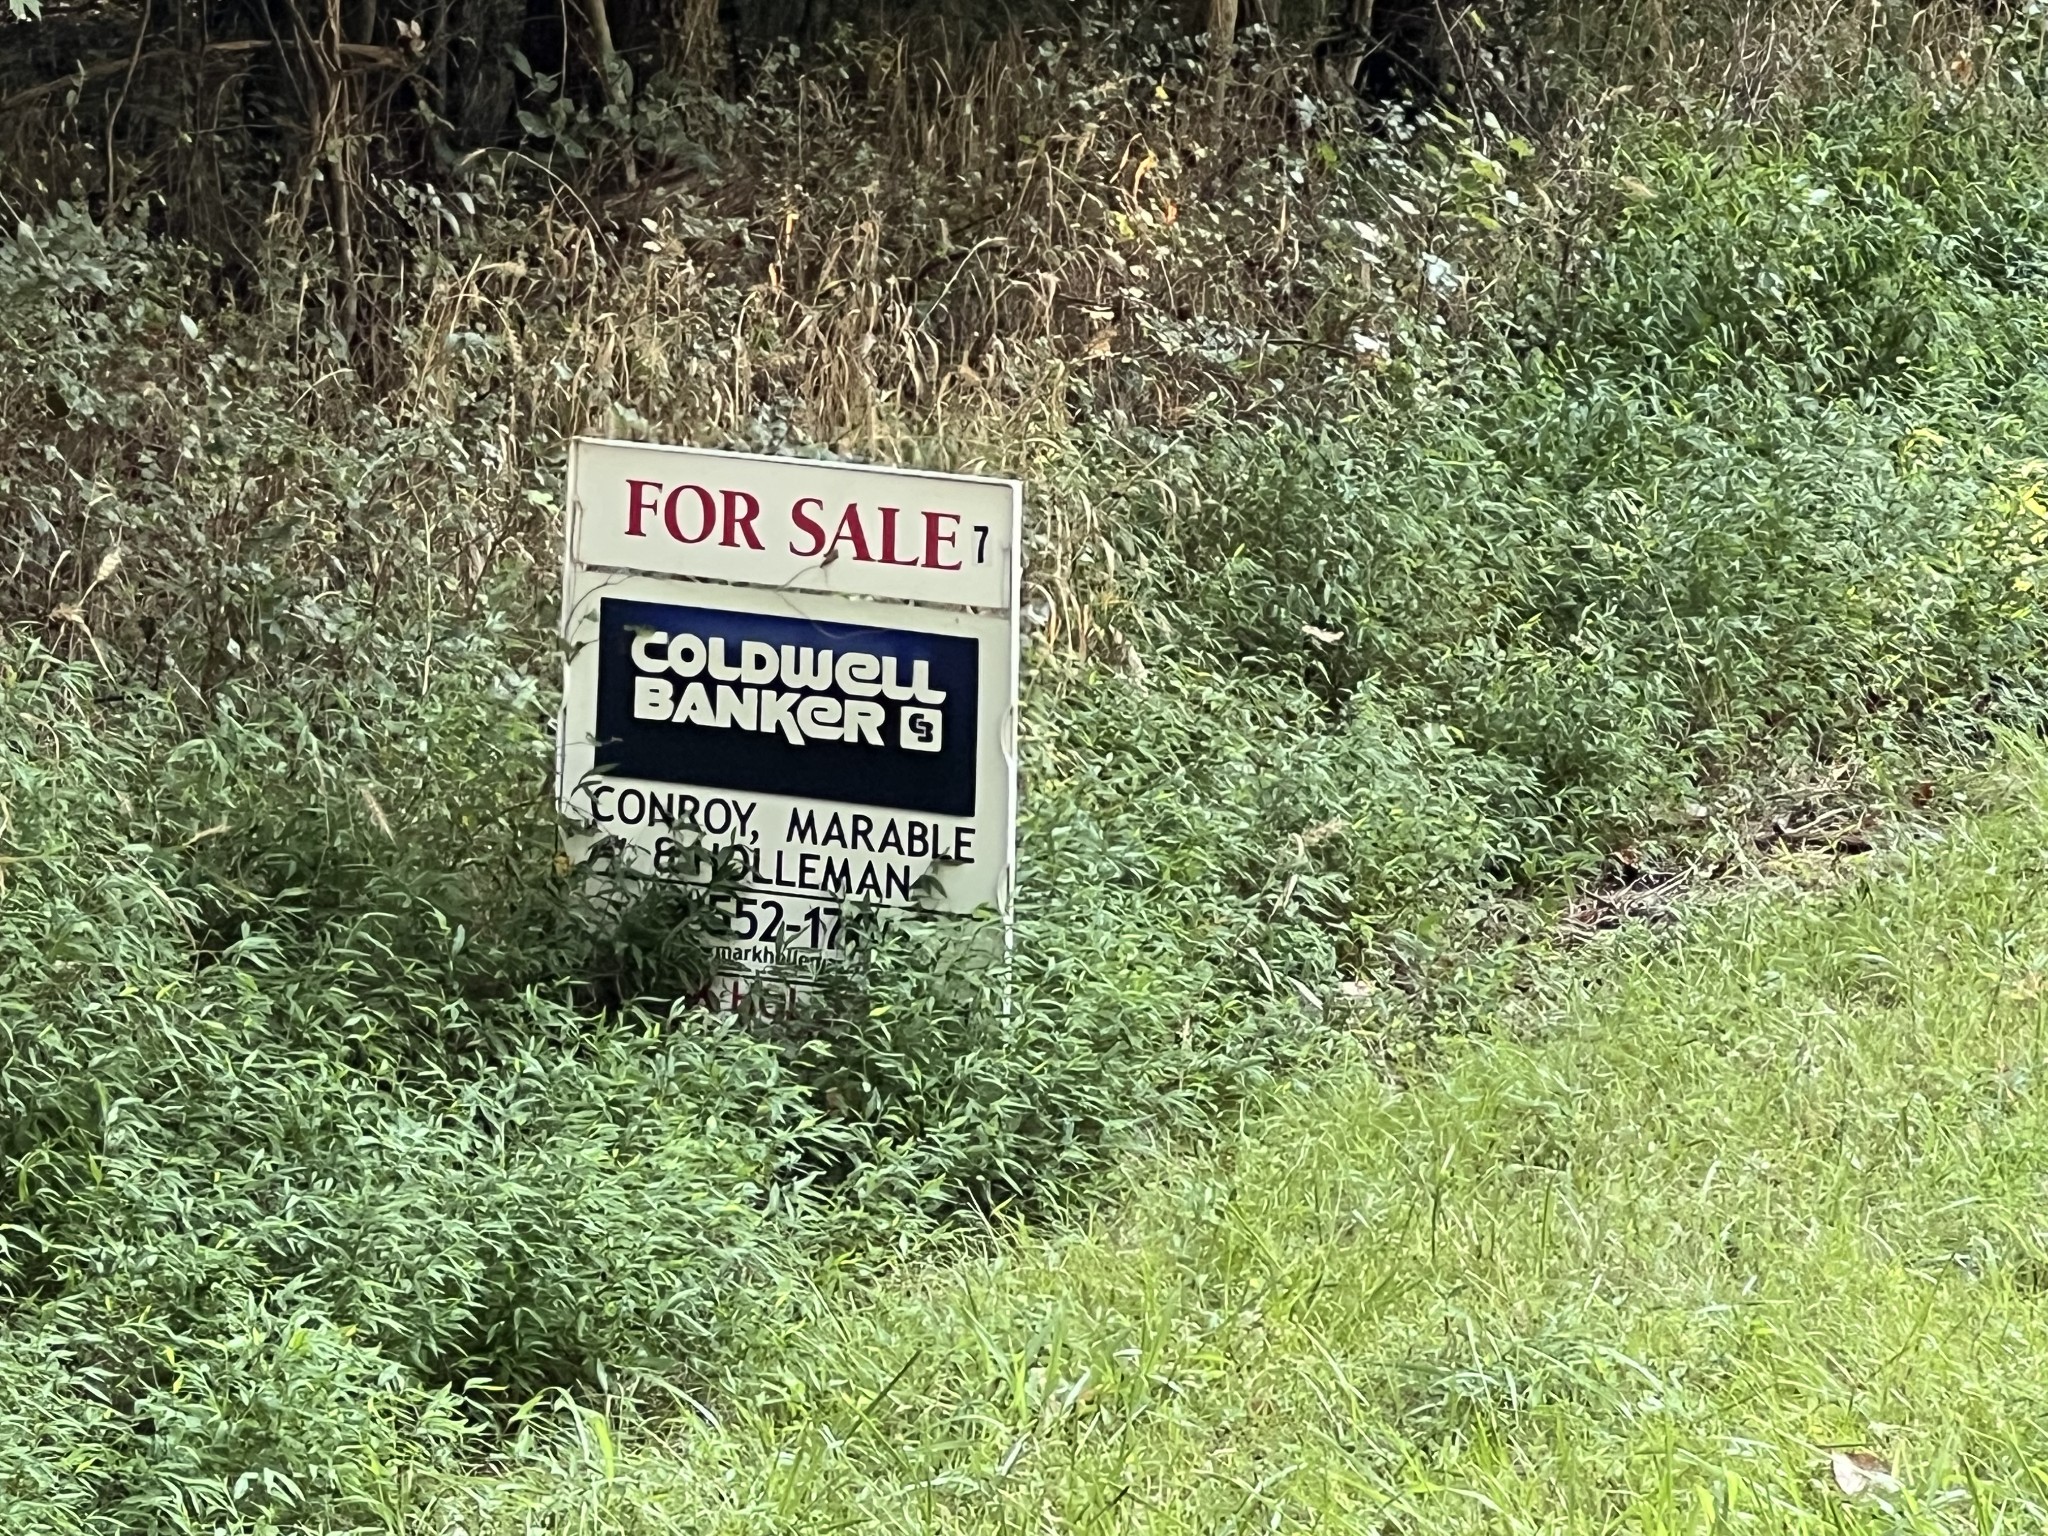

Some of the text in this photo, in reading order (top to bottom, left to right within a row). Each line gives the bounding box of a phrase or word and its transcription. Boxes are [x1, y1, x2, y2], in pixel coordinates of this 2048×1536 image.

[624, 479, 989, 571] FOR SALE 7
[590, 785, 977, 864] CONROY, MARABLE
